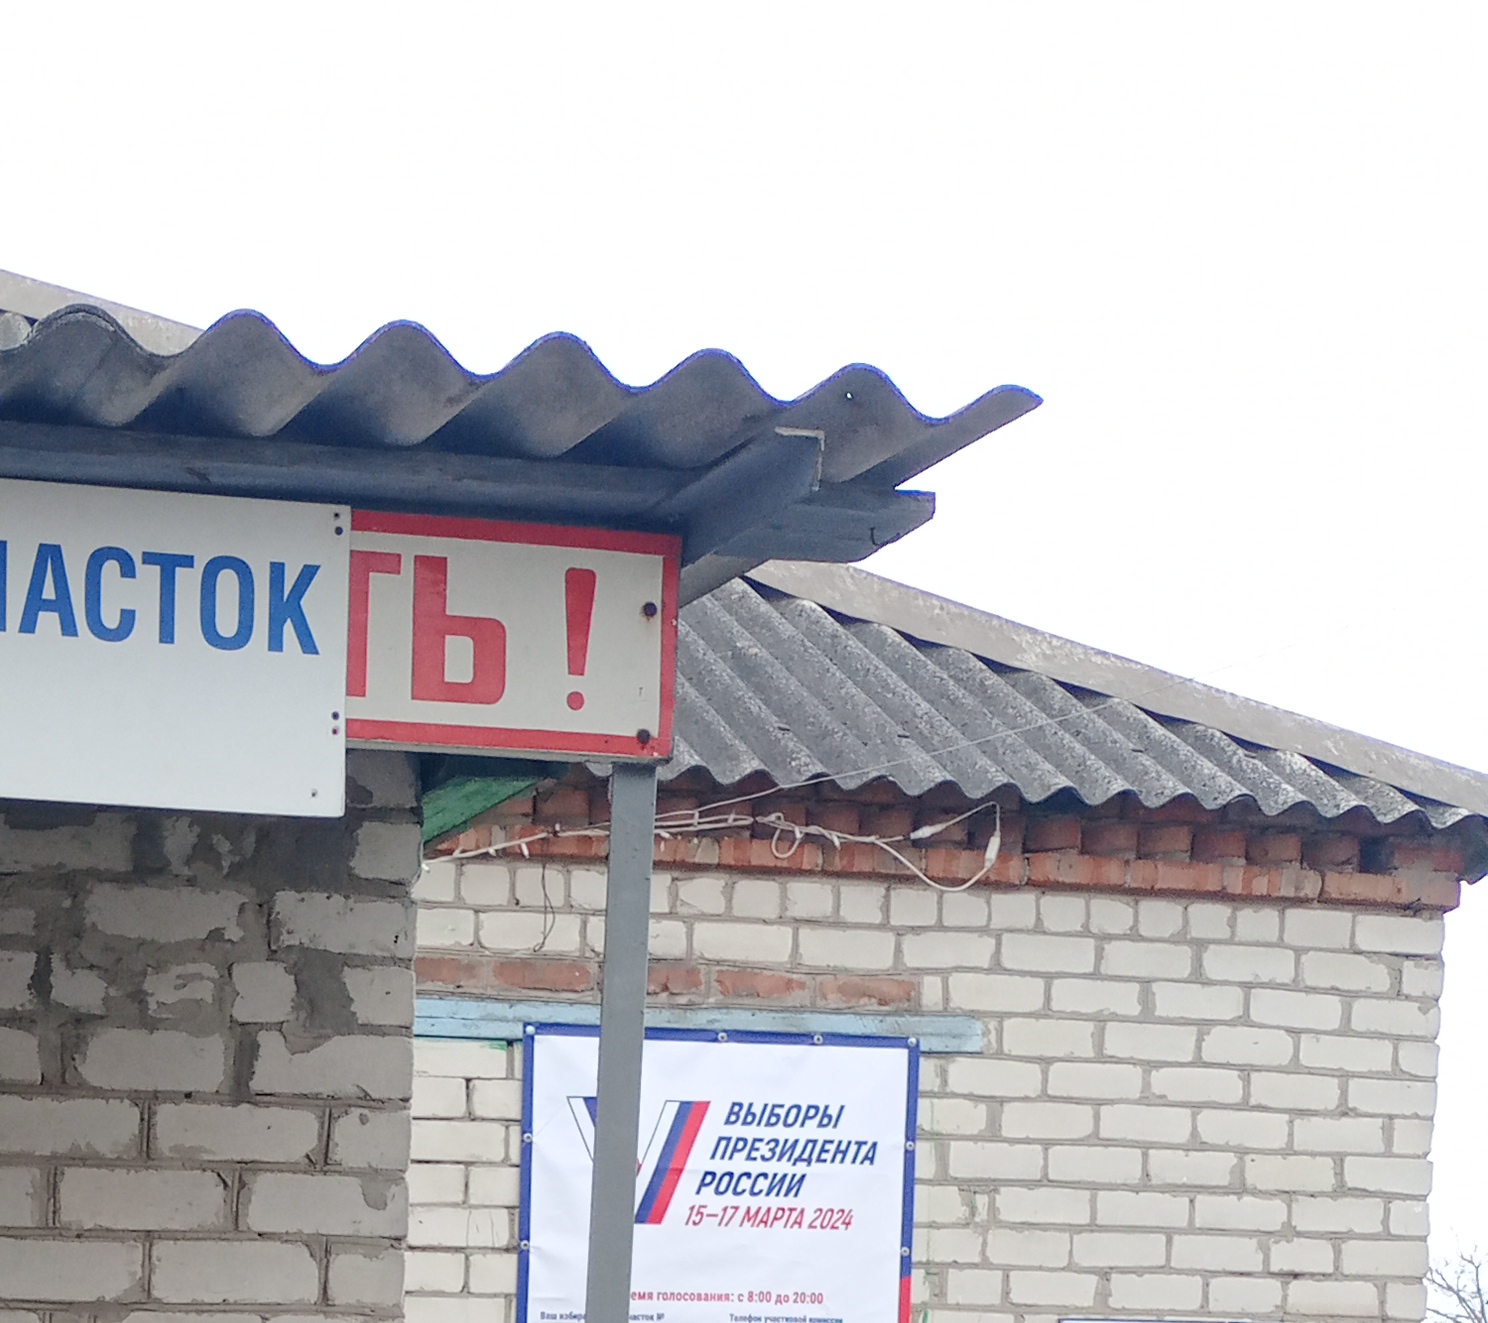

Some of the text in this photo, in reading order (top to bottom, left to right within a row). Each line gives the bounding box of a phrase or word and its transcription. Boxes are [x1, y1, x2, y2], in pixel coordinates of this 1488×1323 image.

[724, 1101, 846, 1129] ВЫБОРЫ
[711, 1135, 879, 1167] ПРЕЗИДЕНТА
[696, 1170, 807, 1198] РОССИИ
[741, 1206, 805, 1229] МАРТА
[808, 1208, 854, 1231] 2024
[631, 1290, 824, 1305] емя голосования: с 8:00 до 20:00
